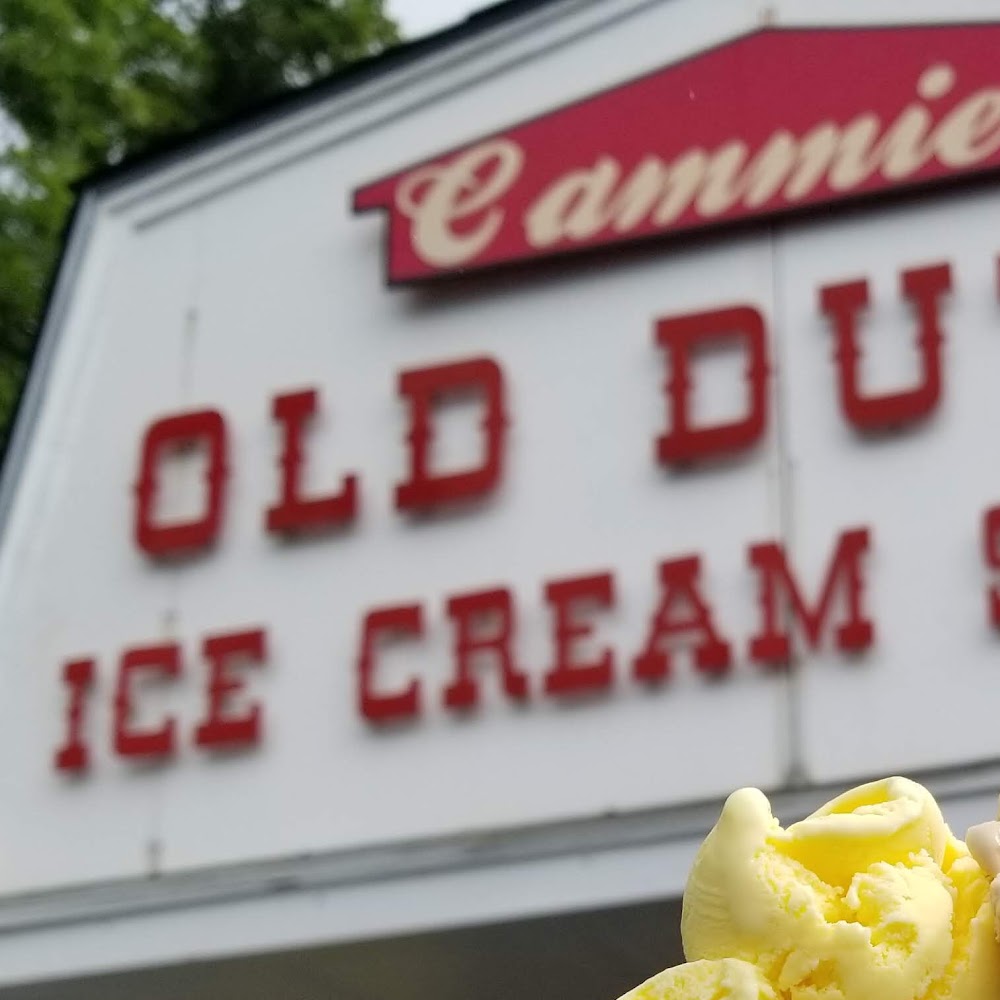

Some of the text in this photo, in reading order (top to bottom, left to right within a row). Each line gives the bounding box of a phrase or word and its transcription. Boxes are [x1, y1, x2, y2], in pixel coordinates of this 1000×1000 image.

[137, 357, 507, 555] OLD
[55, 627, 267, 773] ICE
[358, 528, 874, 722] CREAM
